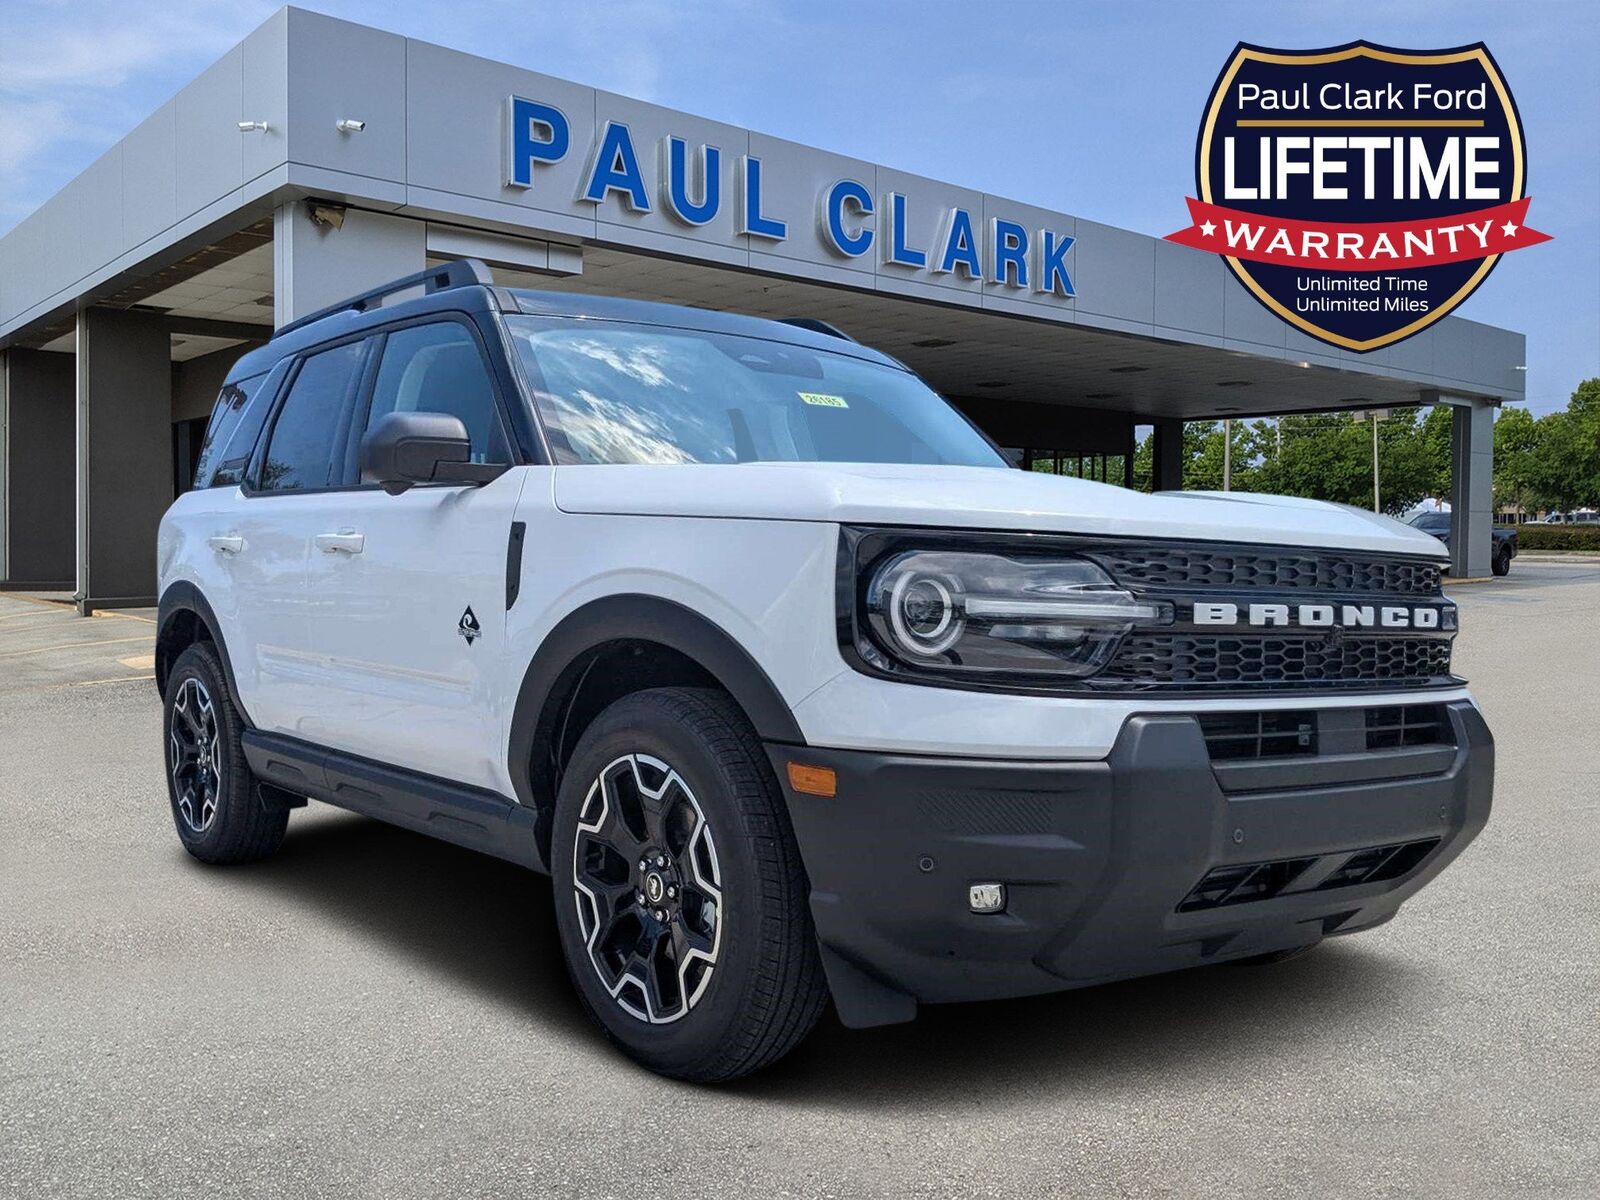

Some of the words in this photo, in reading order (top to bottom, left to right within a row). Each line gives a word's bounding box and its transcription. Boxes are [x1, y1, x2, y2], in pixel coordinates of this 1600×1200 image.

[507, 95, 789, 241] PAUL
[824, 178, 1078, 298] CLARK
[1193, 602, 1438, 628] BRONCO
